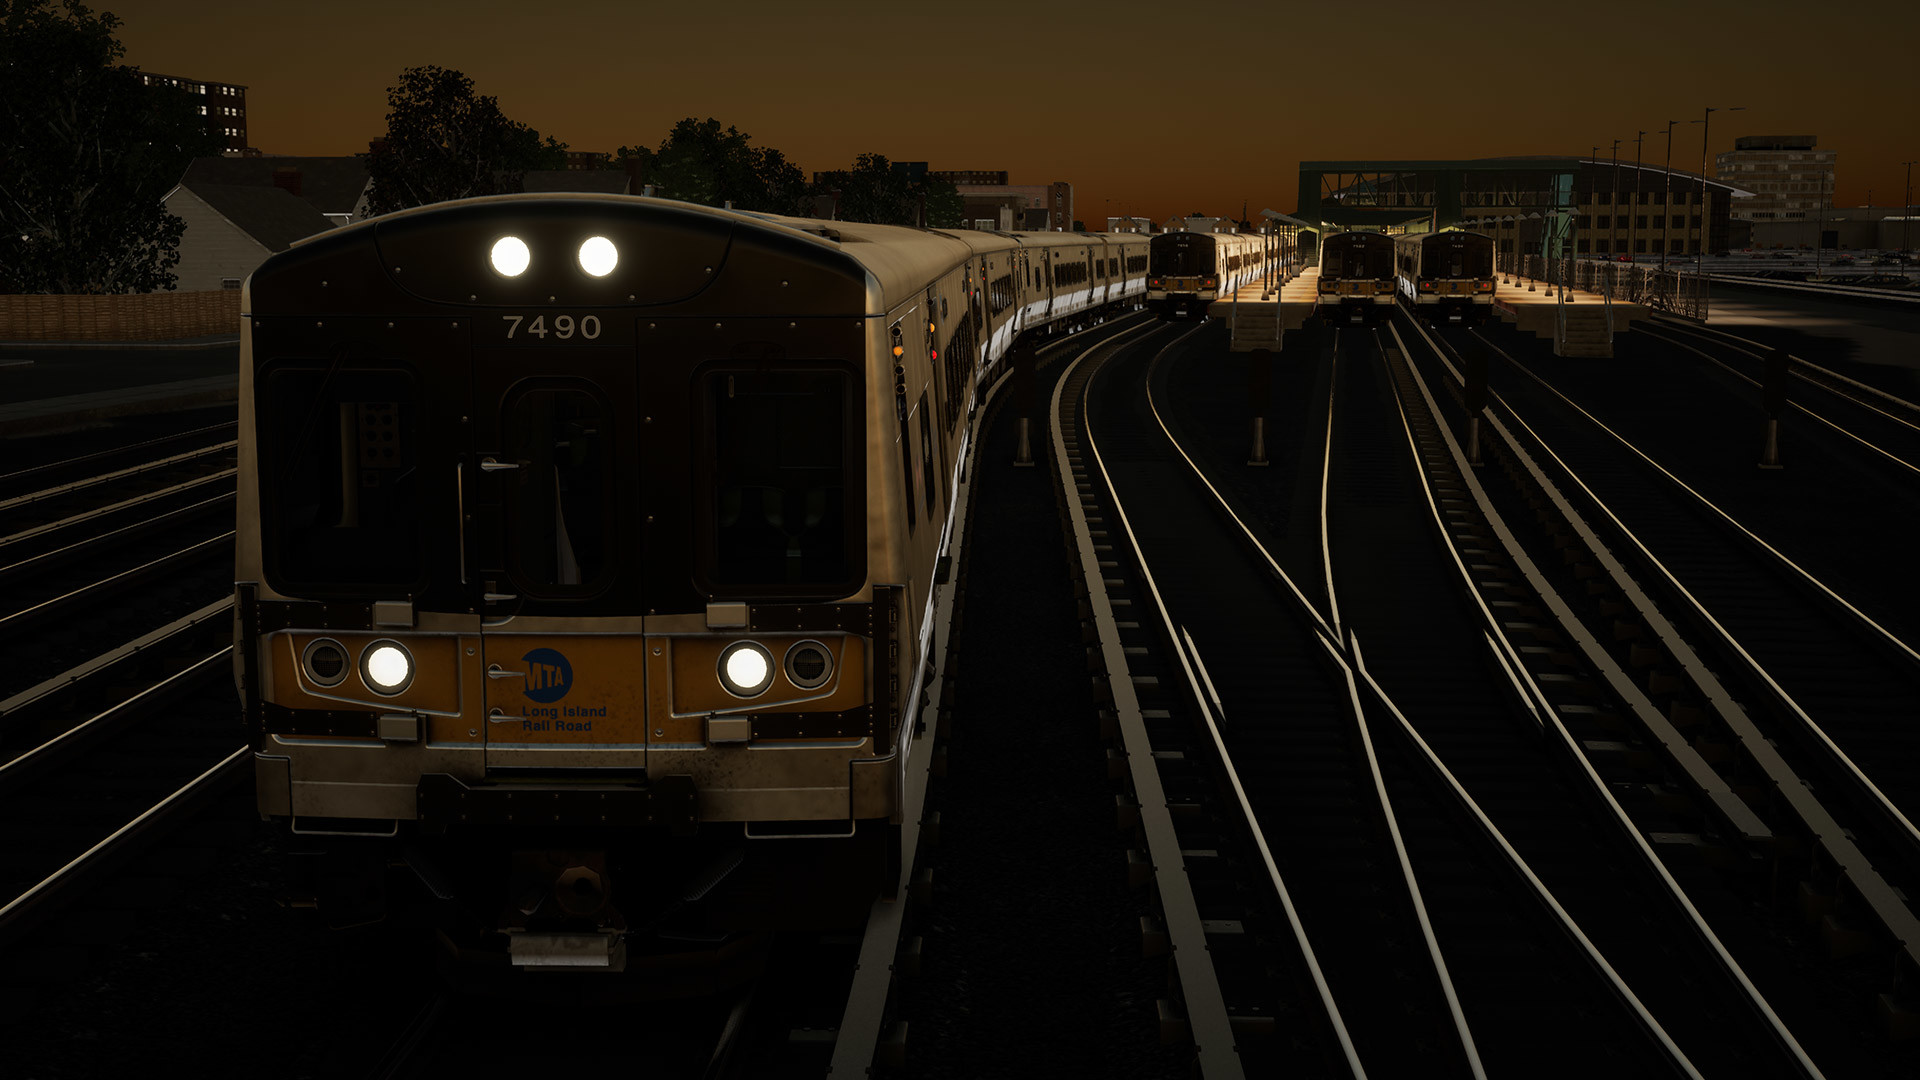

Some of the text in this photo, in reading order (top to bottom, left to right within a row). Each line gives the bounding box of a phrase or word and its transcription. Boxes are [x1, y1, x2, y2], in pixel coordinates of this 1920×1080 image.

[502, 314, 602, 340] 7490
[521, 660, 565, 692] MTA
[522, 705, 607, 720] Long Island
[523, 720, 592, 732] Rail Road
